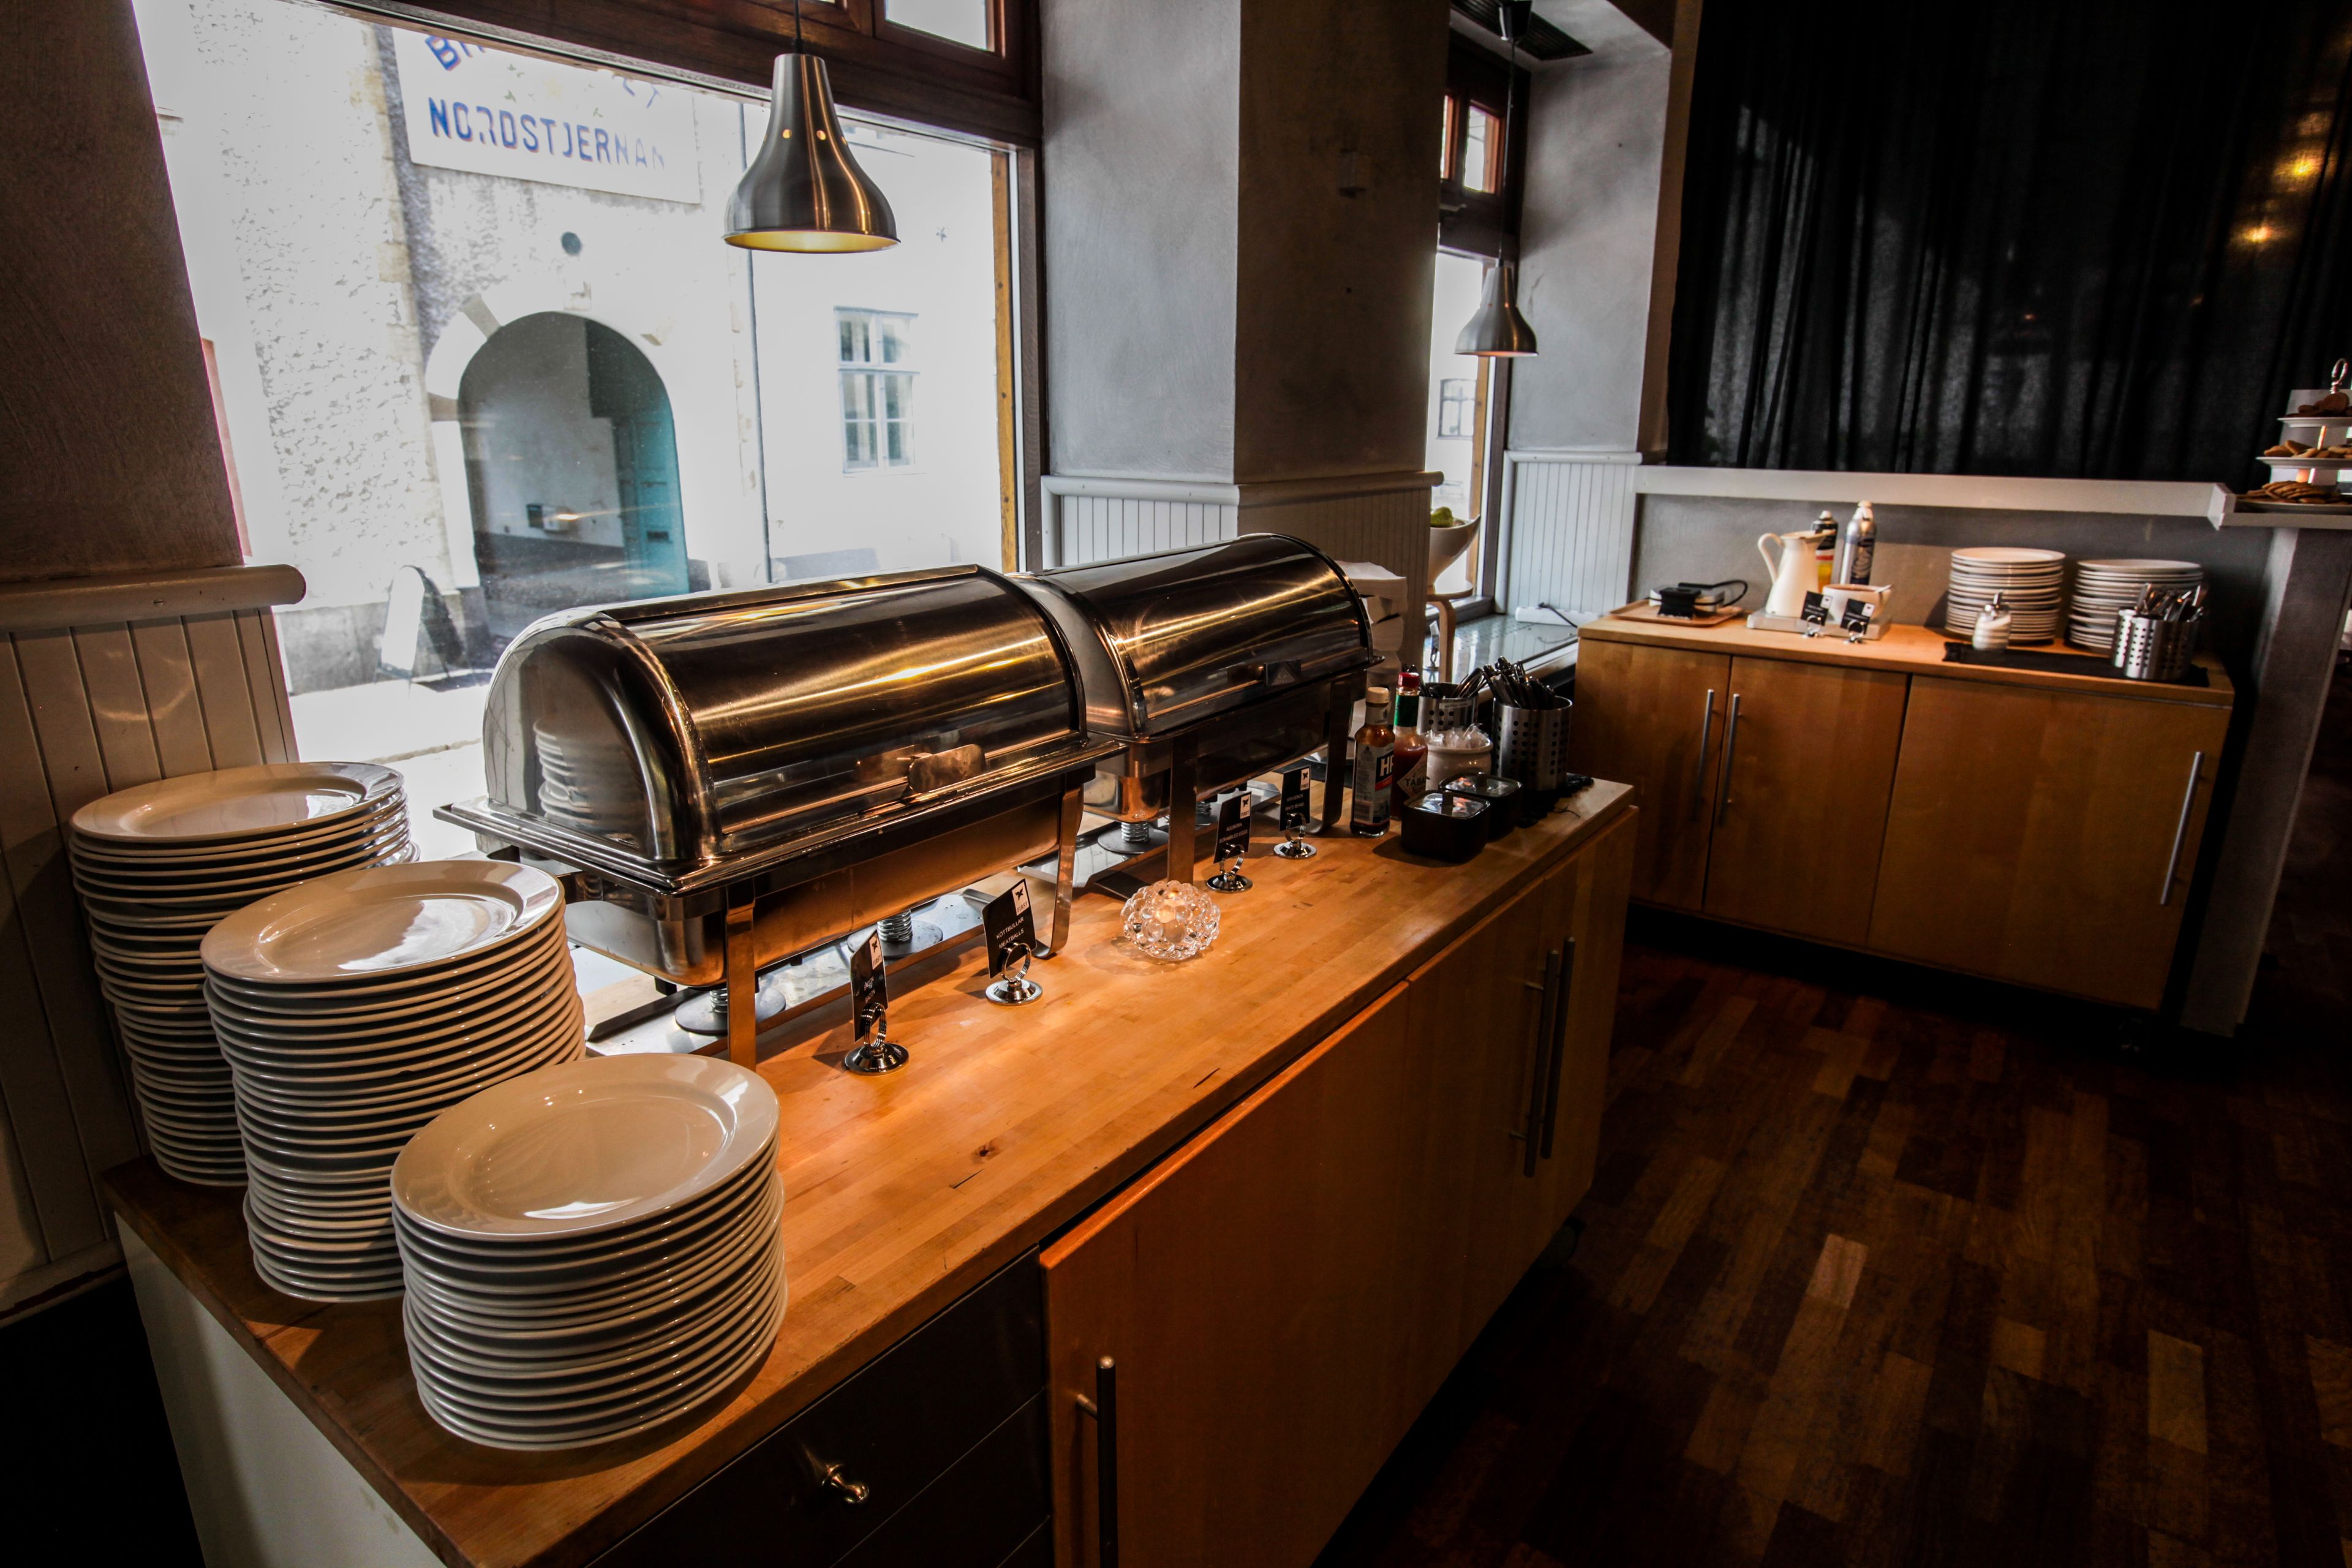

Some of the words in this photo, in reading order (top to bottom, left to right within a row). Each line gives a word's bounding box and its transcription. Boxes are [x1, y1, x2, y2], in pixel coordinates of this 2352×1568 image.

[1017, 902, 1028, 913] FIRST
[999, 928, 1024, 949] MEATBALLS
[873, 955, 881, 967] FIRST
